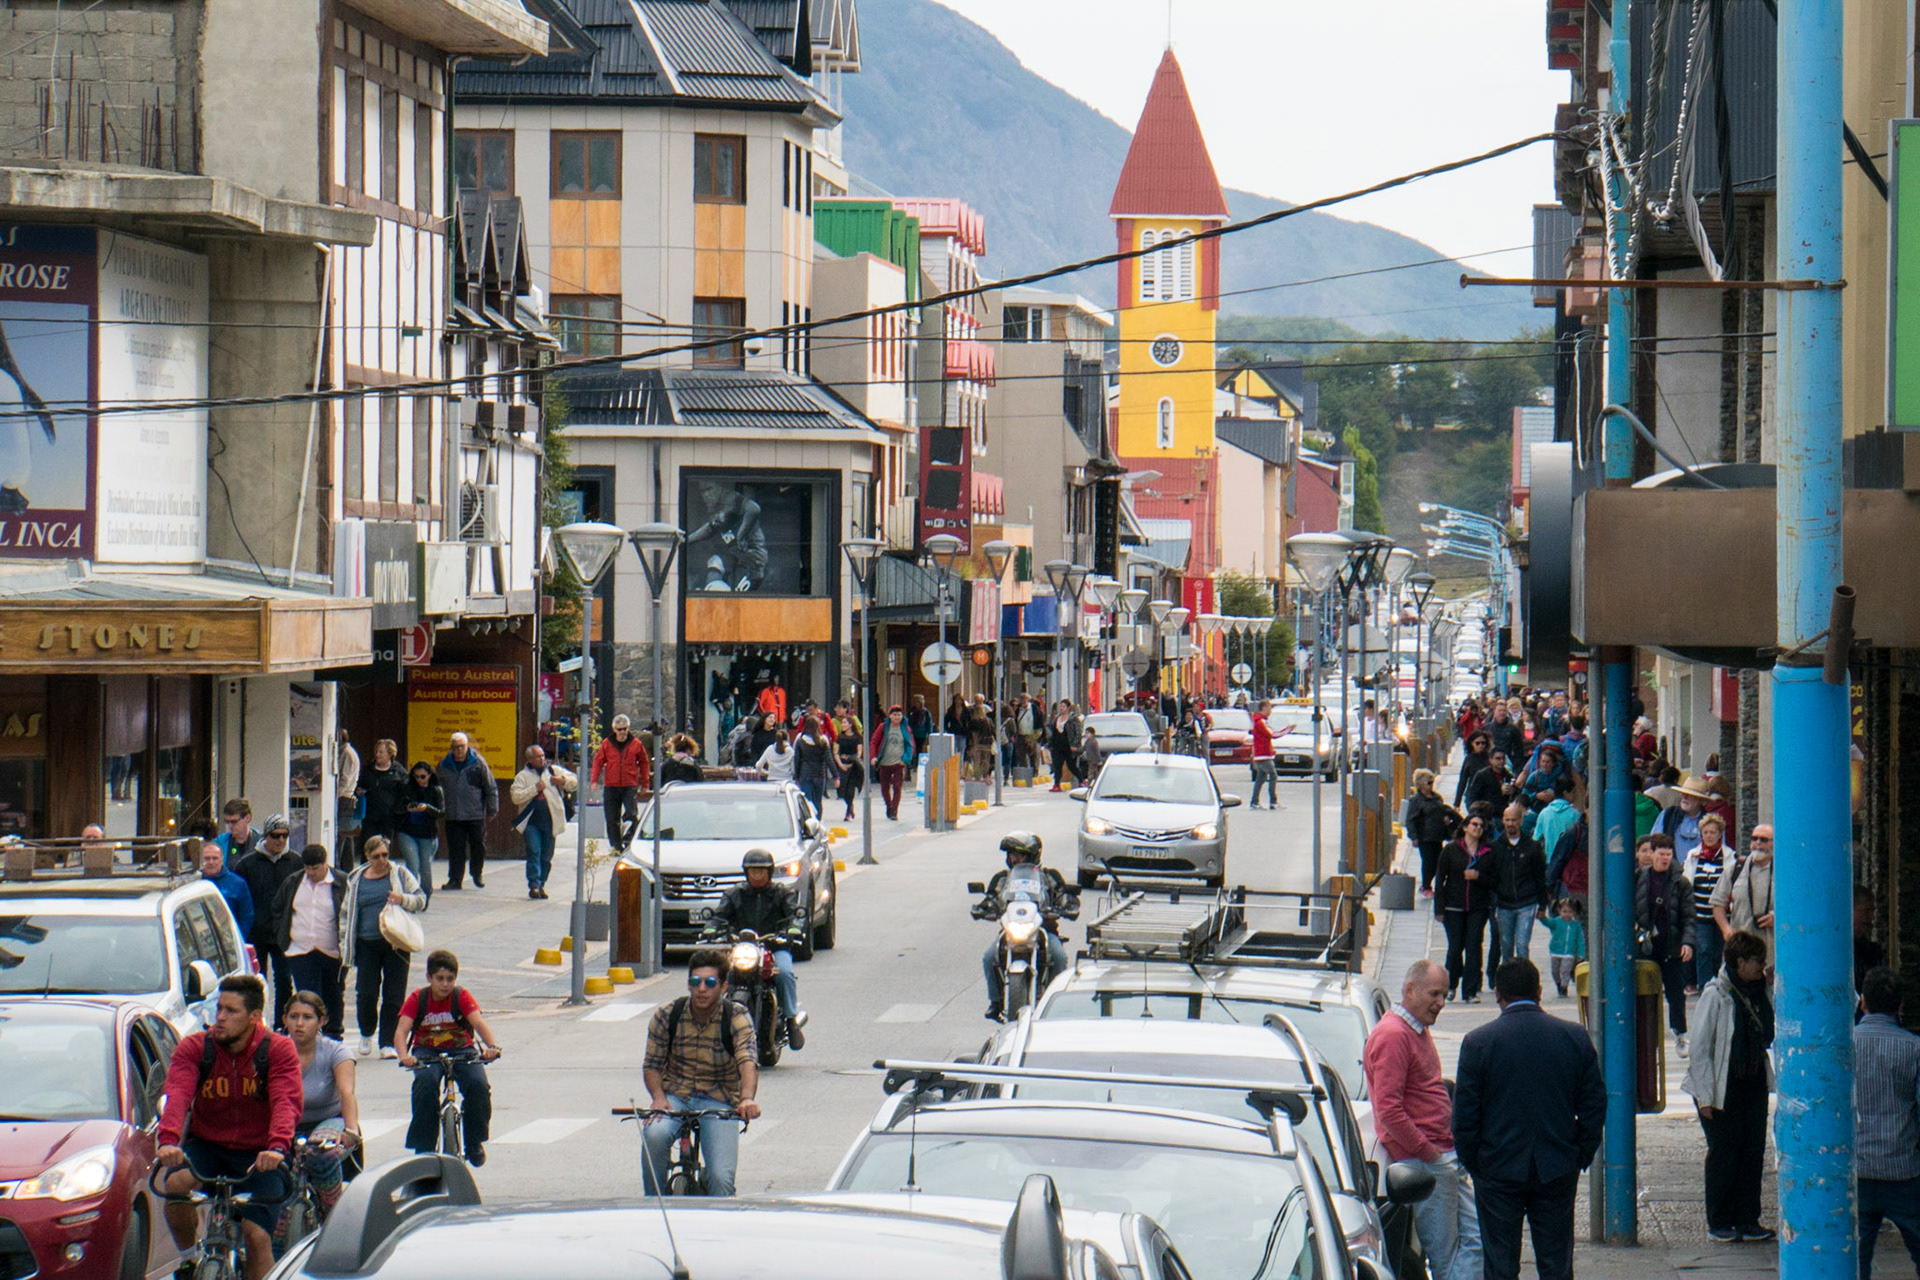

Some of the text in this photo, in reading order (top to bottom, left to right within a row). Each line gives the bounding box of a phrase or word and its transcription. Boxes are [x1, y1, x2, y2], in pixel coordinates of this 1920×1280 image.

[0, 263, 71, 290] ROSE
[14, 521, 82, 548] INCA
[39, 624, 203, 650] STONES
[411, 669, 515, 681] Puerto Austral
[413, 689, 512, 699] Austral Harbour
[2, 713, 42, 737] AS
[202, 1076, 260, 1099] ROM
